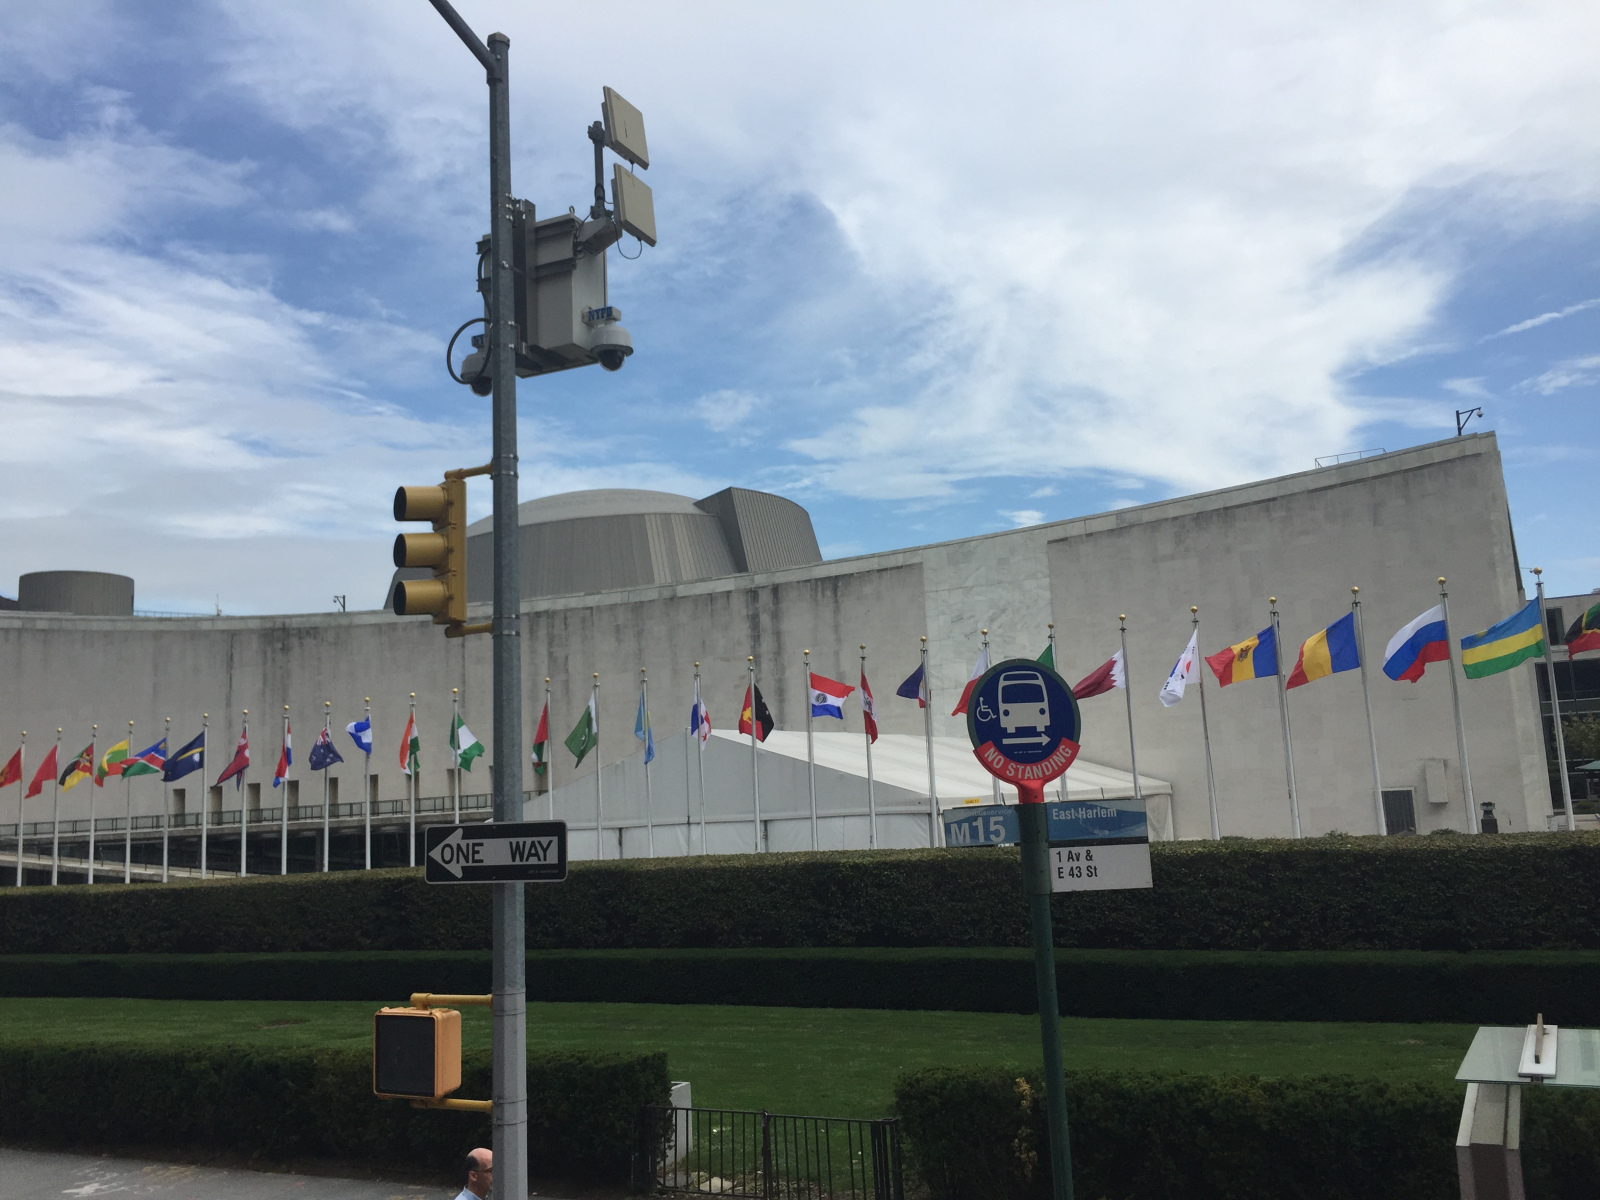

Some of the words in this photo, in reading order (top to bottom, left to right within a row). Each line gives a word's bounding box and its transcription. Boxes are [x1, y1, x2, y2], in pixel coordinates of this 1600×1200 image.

[588, 306, 612, 321] NYPD
[984, 747, 1004, 769] NO
[1006, 745, 1072, 780] STANDING
[1052, 808, 1075, 820] East
[1079, 806, 1117, 819] Harlem
[950, 815, 1006, 845] M15
[440, 842, 484, 865] ONE
[509, 839, 553, 863] WAY
[1056, 850, 1062, 863] 1
[1067, 850, 1081, 862] Av
[1085, 849, 1093, 862] &
[1057, 867, 1064, 879] E
[1068, 866, 1082, 879] 43
[1086, 865, 1098, 878] St
